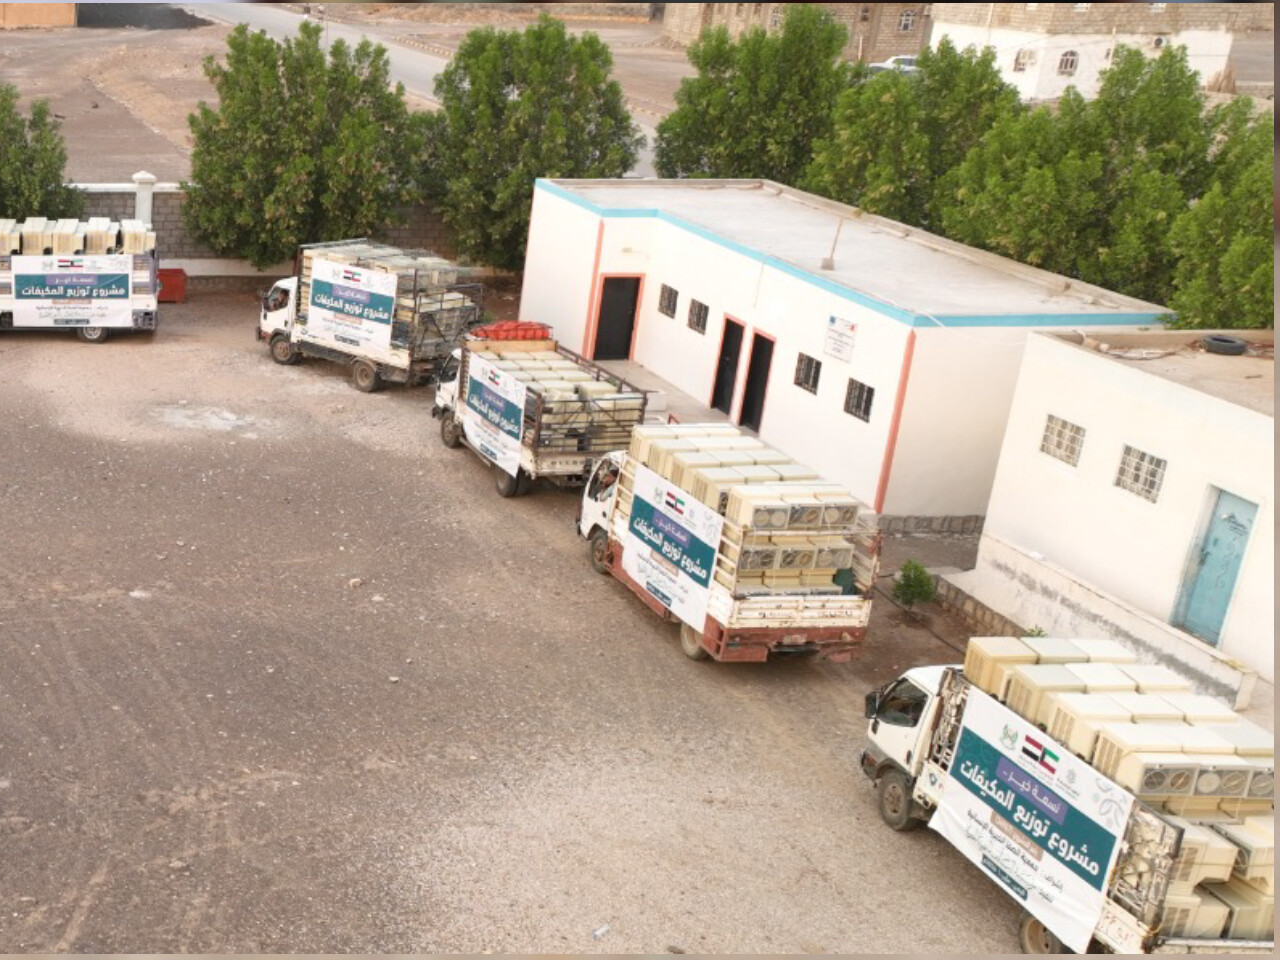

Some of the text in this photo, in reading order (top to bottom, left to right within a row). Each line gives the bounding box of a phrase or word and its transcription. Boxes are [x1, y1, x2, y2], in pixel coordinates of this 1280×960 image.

[21, 284, 126, 298] مشروع توزيع المكيفات
[960, 760, 1016, 811] المكيفات
[1013, 805, 1051, 838] توزيع
[1047, 833, 1099, 876] مشروع
